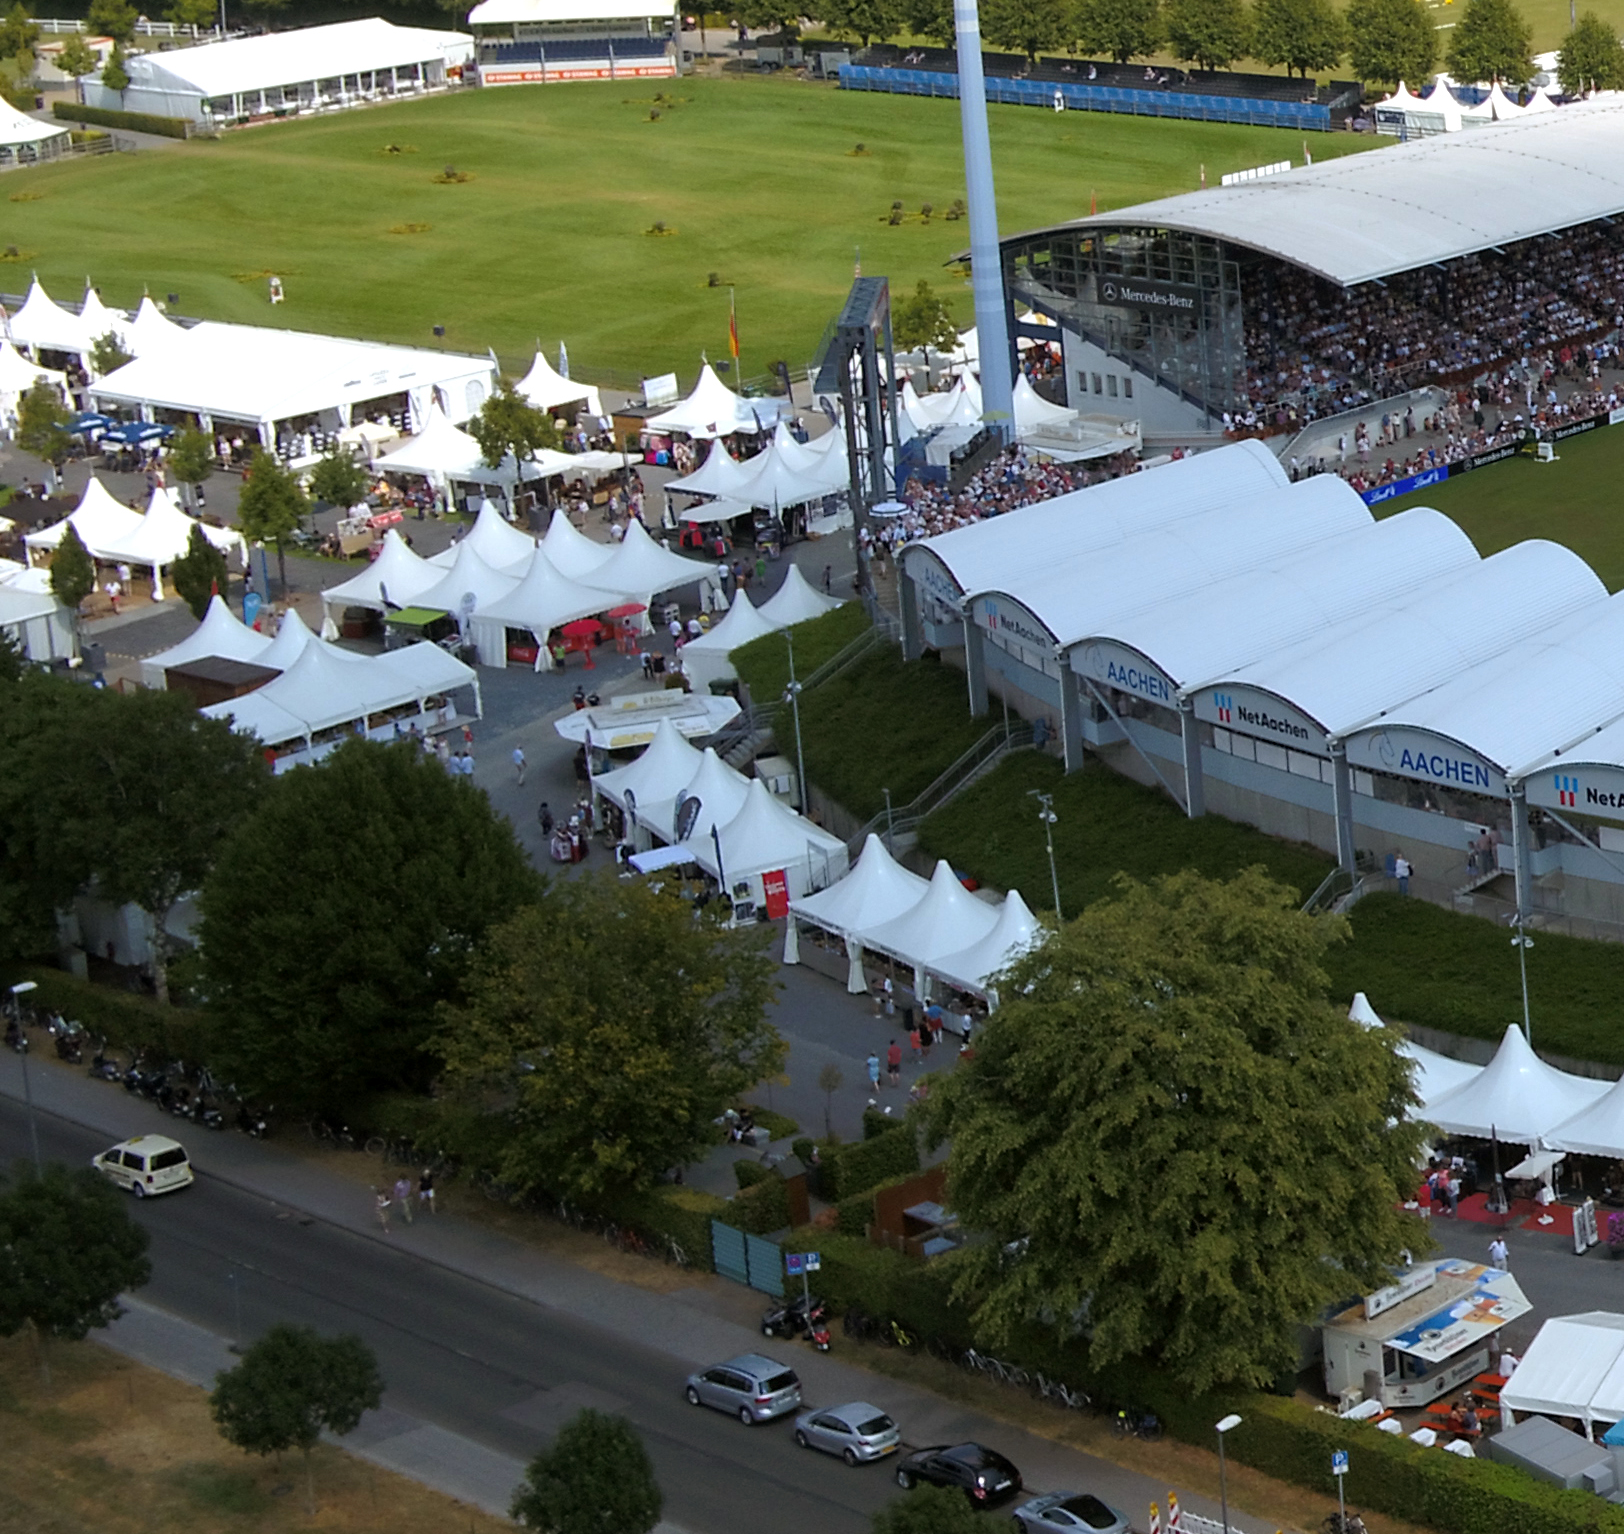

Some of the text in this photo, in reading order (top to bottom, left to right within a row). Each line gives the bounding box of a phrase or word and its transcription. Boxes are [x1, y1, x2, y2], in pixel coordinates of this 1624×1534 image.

[1120, 287, 1193, 309] Mercedes-Benz
[1370, 486, 1393, 503] Lindt
[1414, 470, 1436, 487] Lindt
[925, 568, 959, 603] AACHEN
[1001, 614, 1046, 648] NetAachen
[1107, 661, 1169, 701] AACHEN
[1238, 705, 1309, 740] NetAachen
[1400, 748, 1490, 788] AACHEN
